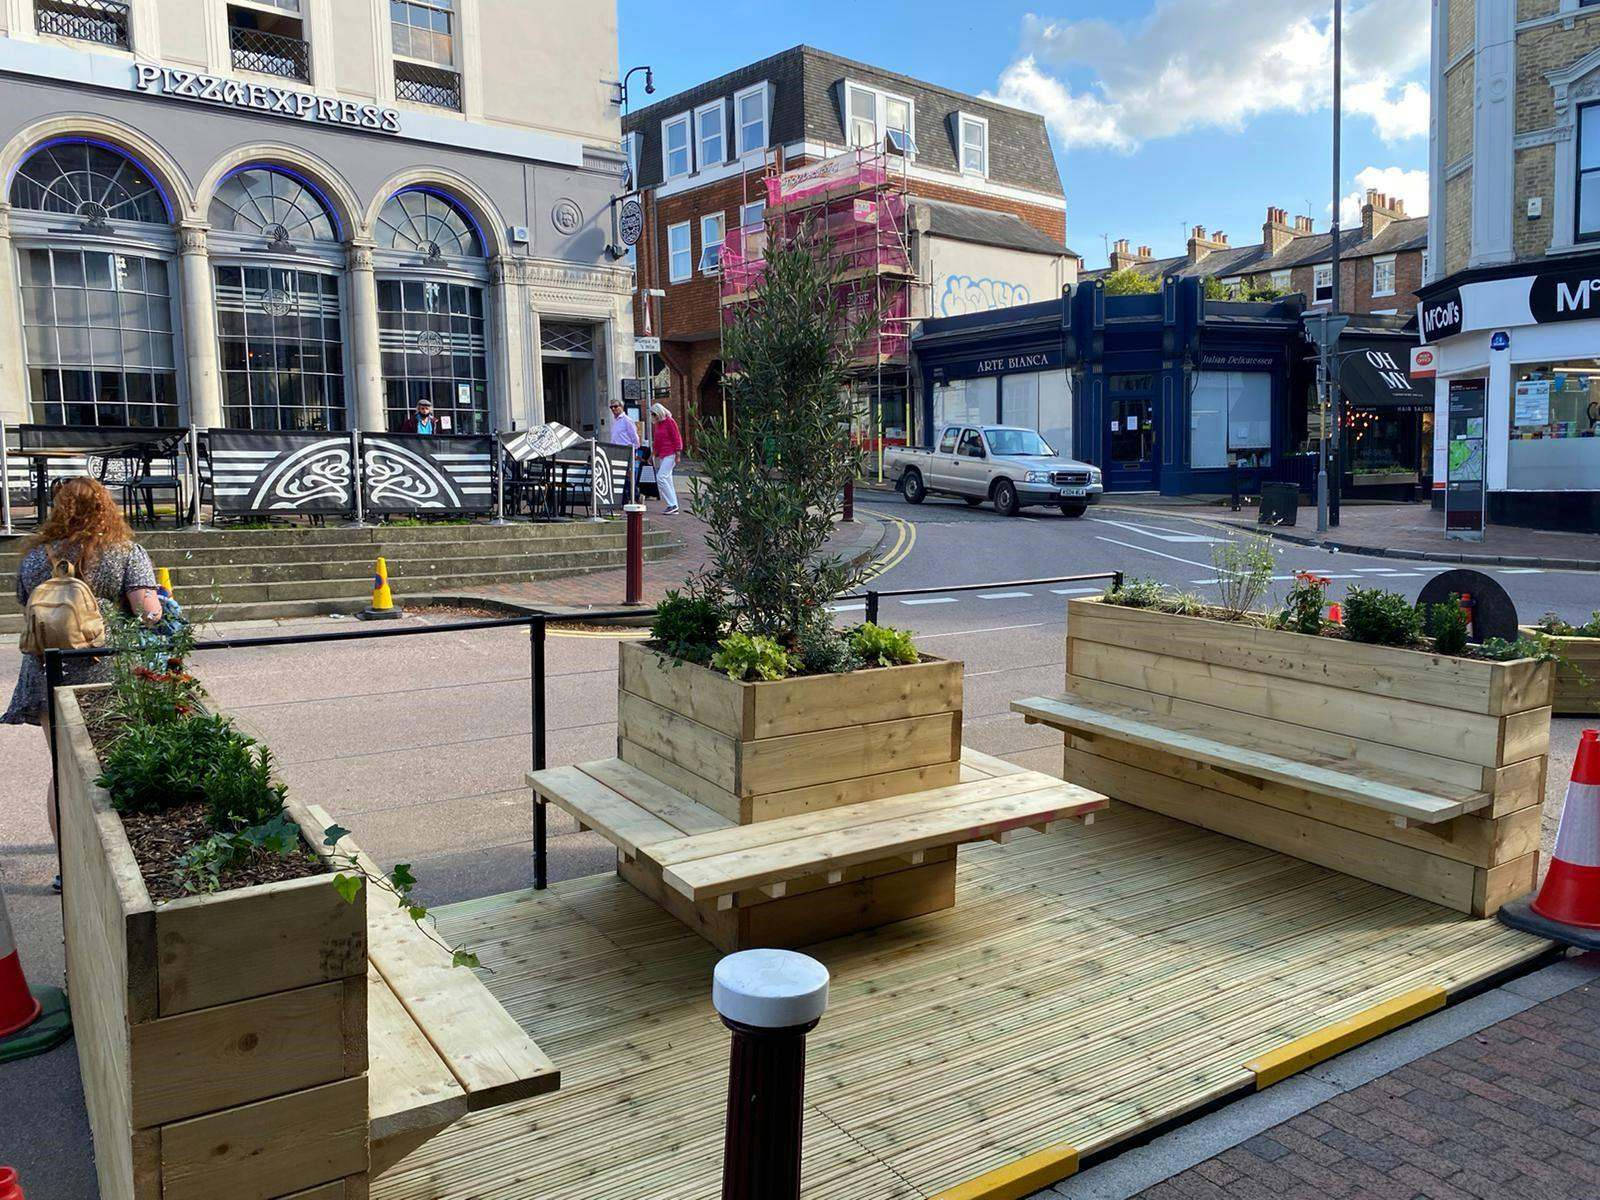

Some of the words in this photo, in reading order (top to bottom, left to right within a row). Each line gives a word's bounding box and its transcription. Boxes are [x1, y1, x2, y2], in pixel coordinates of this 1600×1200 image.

[135, 63, 402, 132] PIZZAEXPRESS
[1424, 301, 1460, 333] McColl's
[977, 357, 1004, 372] ARTE
[1008, 353, 1049, 369] BIANCA
[1202, 354, 1225, 364] Italian
[1227, 355, 1273, 365] Delicatessen
[1365, 351, 1400, 370] OH
[1377, 371, 1413, 391] MY
